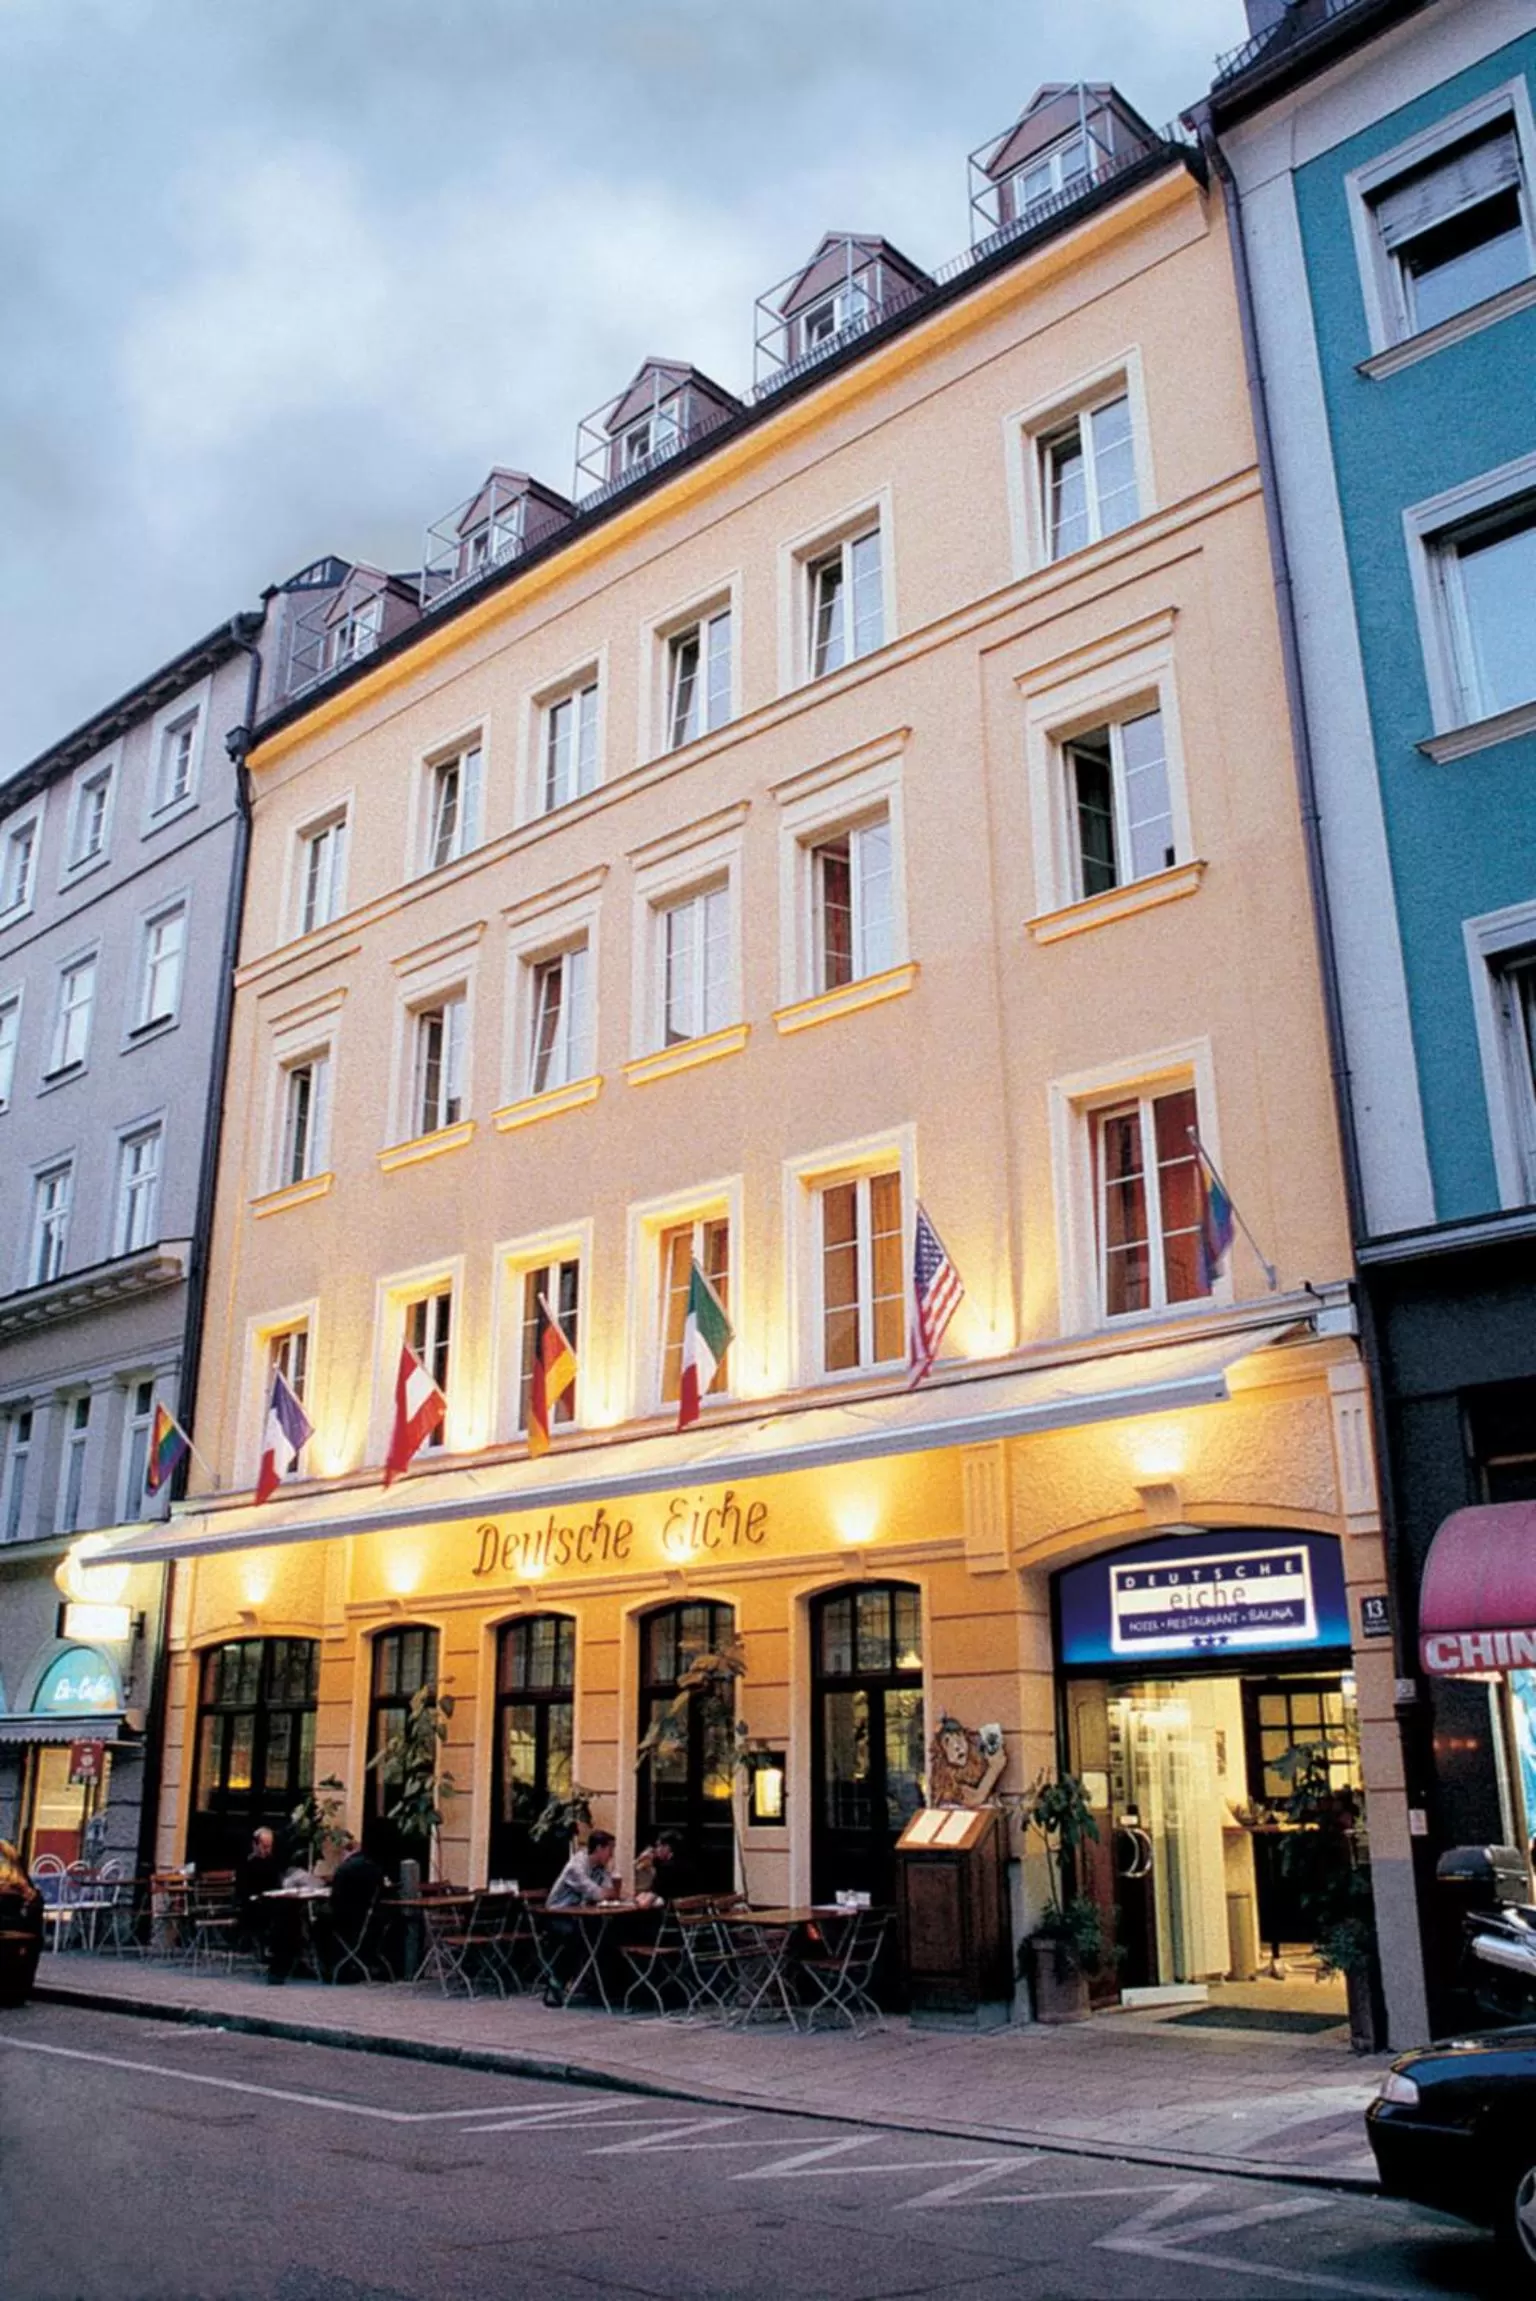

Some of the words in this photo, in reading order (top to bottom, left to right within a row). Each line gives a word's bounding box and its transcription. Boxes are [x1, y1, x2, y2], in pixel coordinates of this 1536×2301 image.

[472, 1507, 633, 1577] Deutsche
[661, 1490, 768, 1551] Eiche
[1124, 1560, 1294, 1589] DEUTSCHE
[1169, 1579, 1246, 1611] eiche
[1366, 1599, 1384, 1618] 13
[1166, 1612, 1239, 1629] RESTAURANT
[1247, 1606, 1294, 1622] SAUNA
[1425, 1630, 1536, 1670] CHIN
